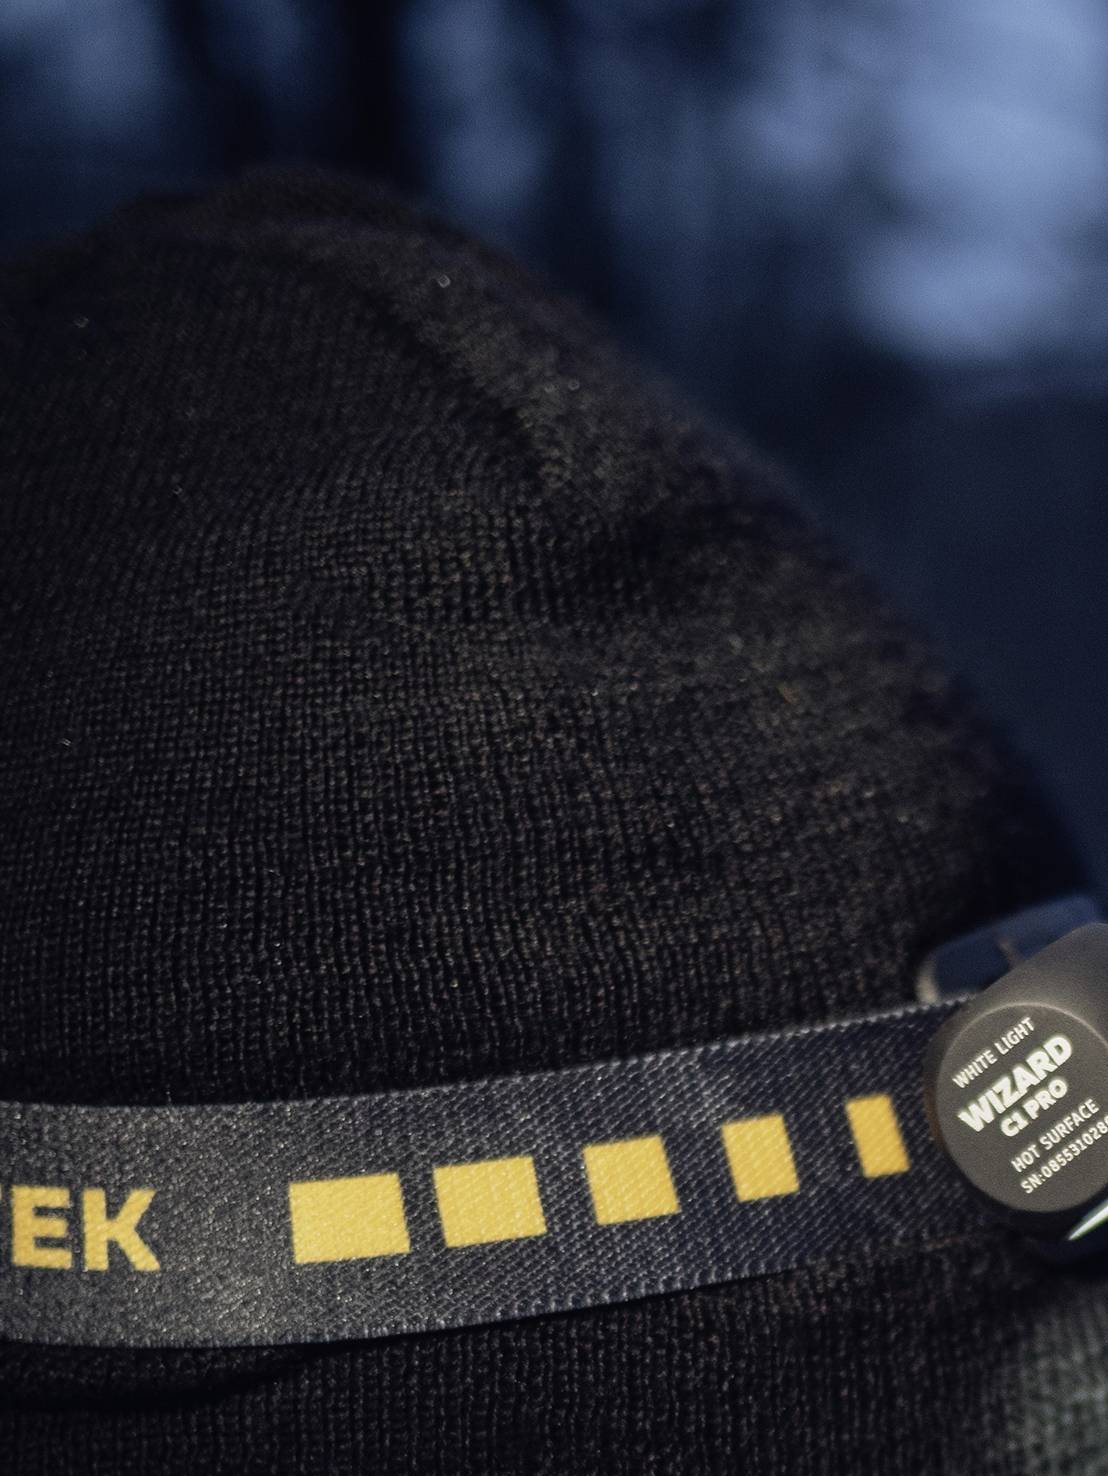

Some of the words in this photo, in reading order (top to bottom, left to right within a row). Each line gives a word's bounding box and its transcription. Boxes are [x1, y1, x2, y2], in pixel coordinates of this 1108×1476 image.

[952, 1049, 997, 1088] WHITE
[995, 1017, 1035, 1055] LIGHT
[958, 1035, 1072, 1132] WIZARD
[1000, 1114, 1029, 1137] C1
[1023, 1079, 1069, 1119] PRO
[1011, 1144, 1040, 1173] HOT
[1039, 1098, 1100, 1150] SURFACE
[0, 1184, 160, 1271] EK
